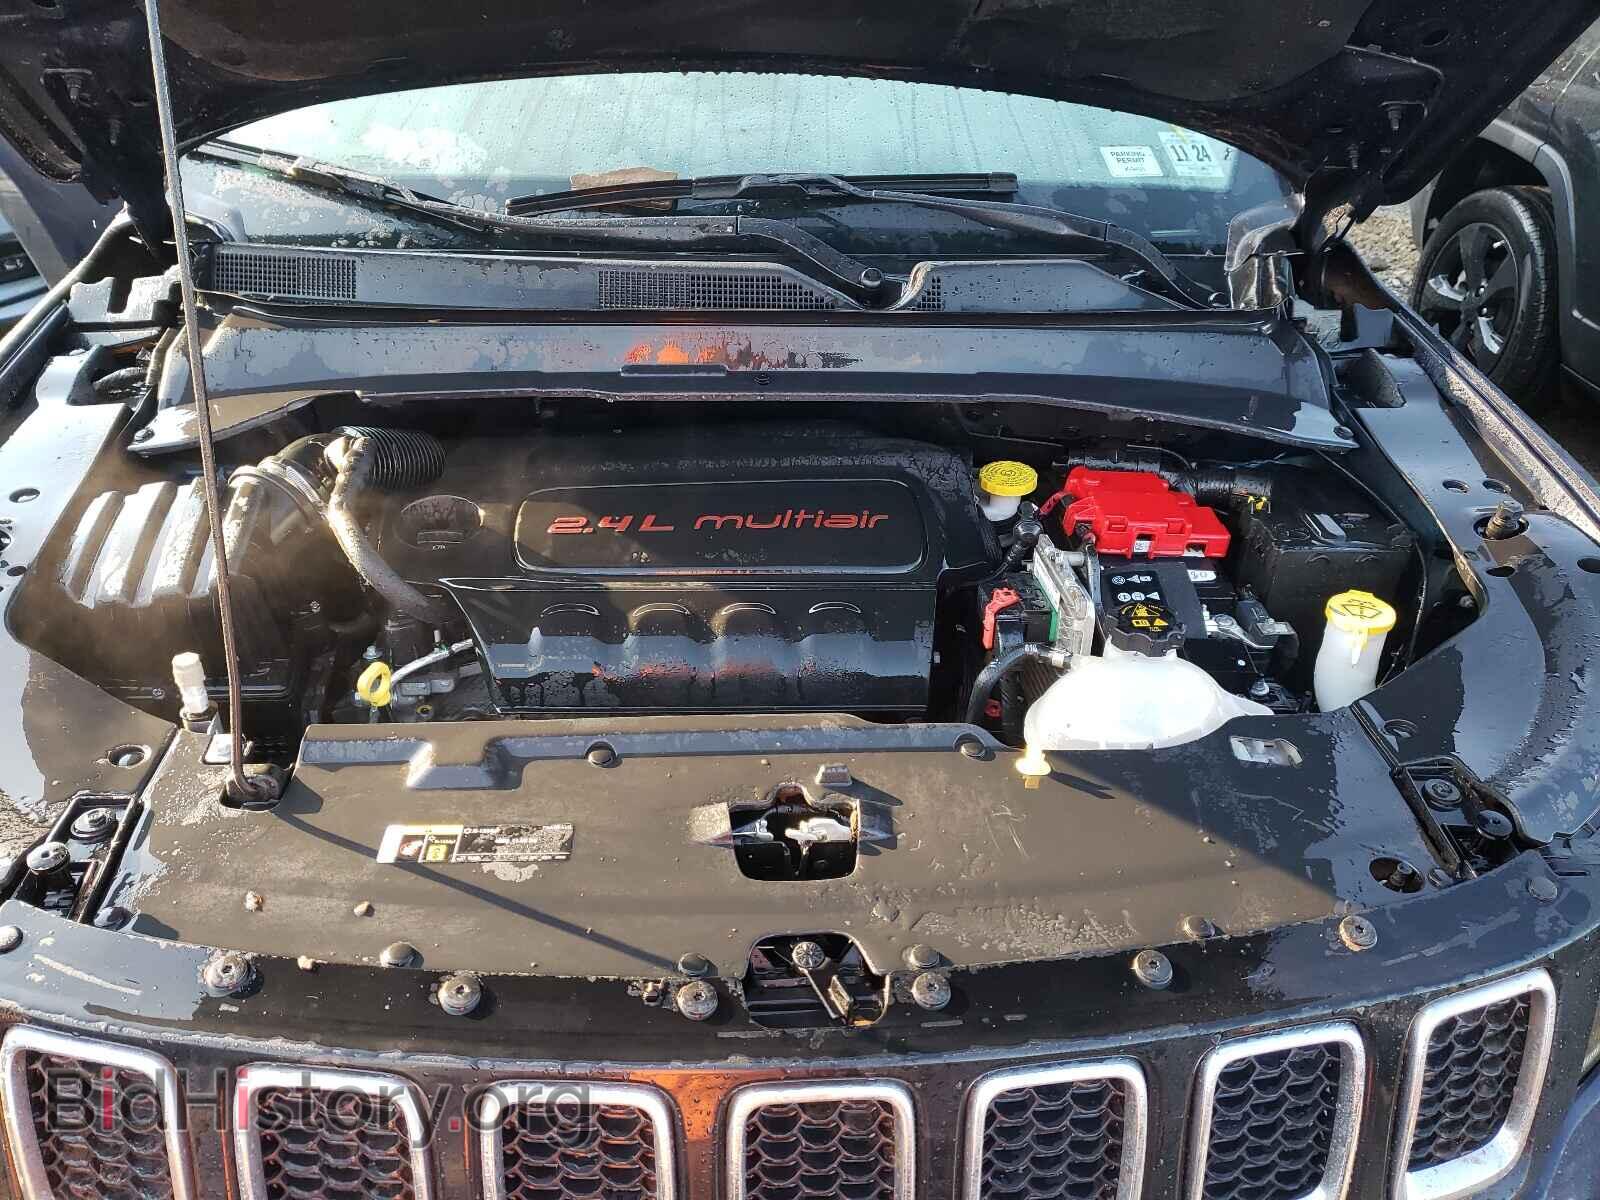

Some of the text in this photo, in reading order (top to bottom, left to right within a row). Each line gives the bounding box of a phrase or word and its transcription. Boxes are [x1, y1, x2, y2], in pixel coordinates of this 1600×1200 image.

[1170, 144, 1191, 162] 11
[1191, 144, 1212, 162] 24
[693, 509, 889, 530] multiair
